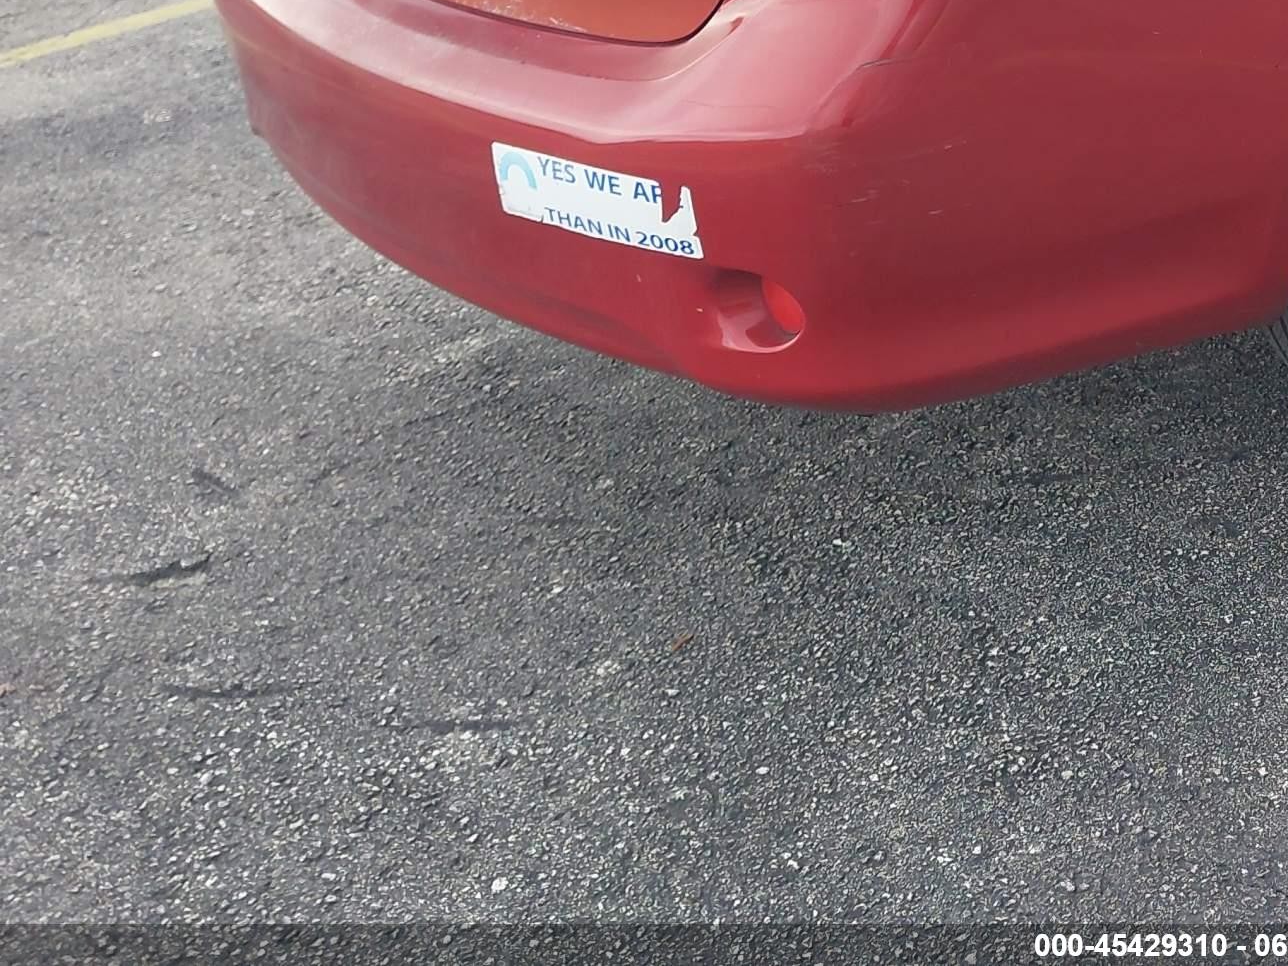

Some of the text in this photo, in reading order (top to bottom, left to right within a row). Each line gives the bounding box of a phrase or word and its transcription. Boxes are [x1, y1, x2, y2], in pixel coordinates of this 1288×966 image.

[537, 156, 576, 184] YES
[584, 169, 622, 196] WE
[544, 207, 695, 255] THAN IN 2008
